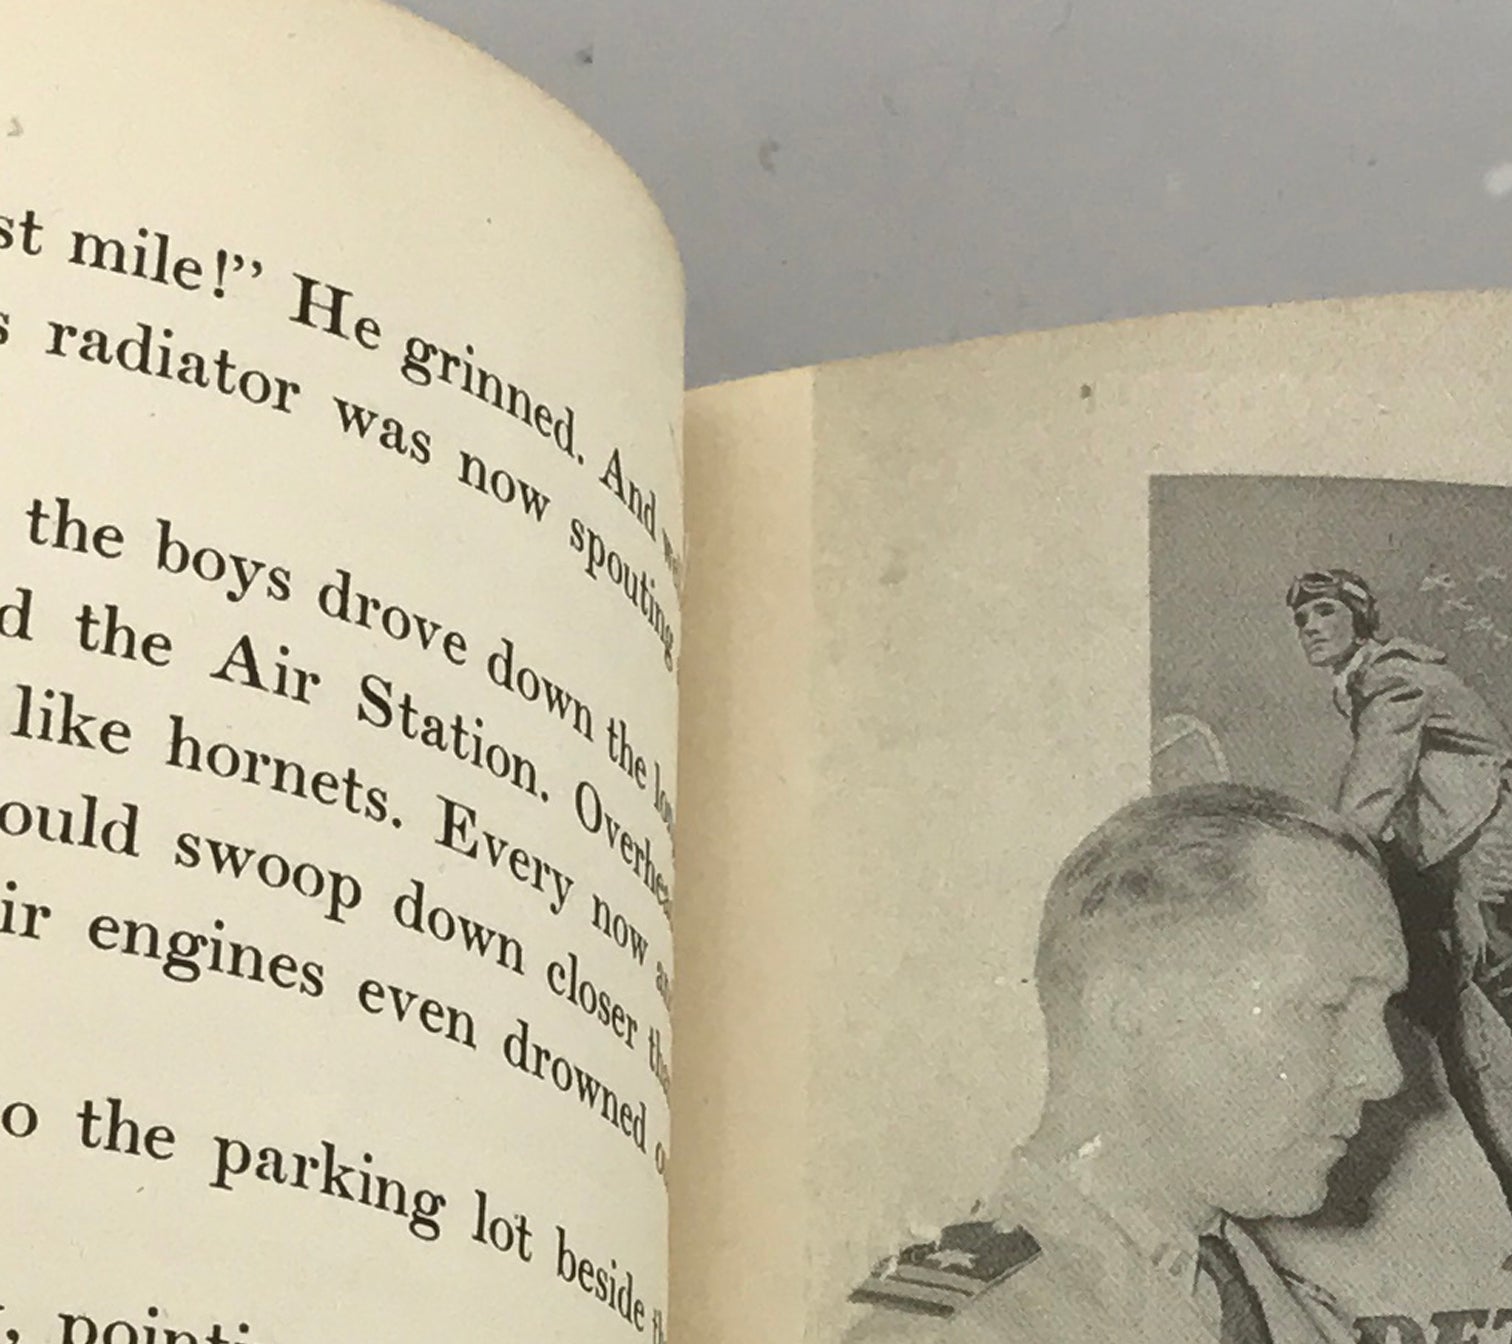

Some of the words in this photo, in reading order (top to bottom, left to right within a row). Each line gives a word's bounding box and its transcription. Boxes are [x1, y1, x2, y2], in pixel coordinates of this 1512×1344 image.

[43, 319, 302, 415] radiator
[331, 394, 433, 467] was
[456, 449, 553, 524] now
[568, 516, 680, 673] spouting
[66, 226, 264, 300] mile!”
[287, 270, 383, 352] He
[399, 335, 586, 467] grinned.
[597, 446, 658, 543] And
[23, 495, 126, 561] the
[154, 516, 292, 604] boys
[316, 567, 469, 667] drove
[485, 635, 595, 744] down
[605, 716, 648, 792] the
[73, 602, 174, 668] the
[207, 633, 323, 707] Air
[356, 666, 550, 805] Station.
[8, 682, 133, 756] like
[163, 712, 404, 831] hornets.
[433, 789, 576, 917] Every
[590, 892, 650, 967] now
[173, 831, 363, 933] swoop
[392, 876, 527, 977] down
[545, 950, 640, 1051] closer
[87, 913, 325, 999] engines
[356, 978, 478, 1052] even
[502, 1017, 648, 1155] drowned
[74, 1095, 177, 1162] the
[207, 1134, 448, 1243] parking
[470, 1187, 534, 1264] lot
[554, 1224, 646, 1334] beside
